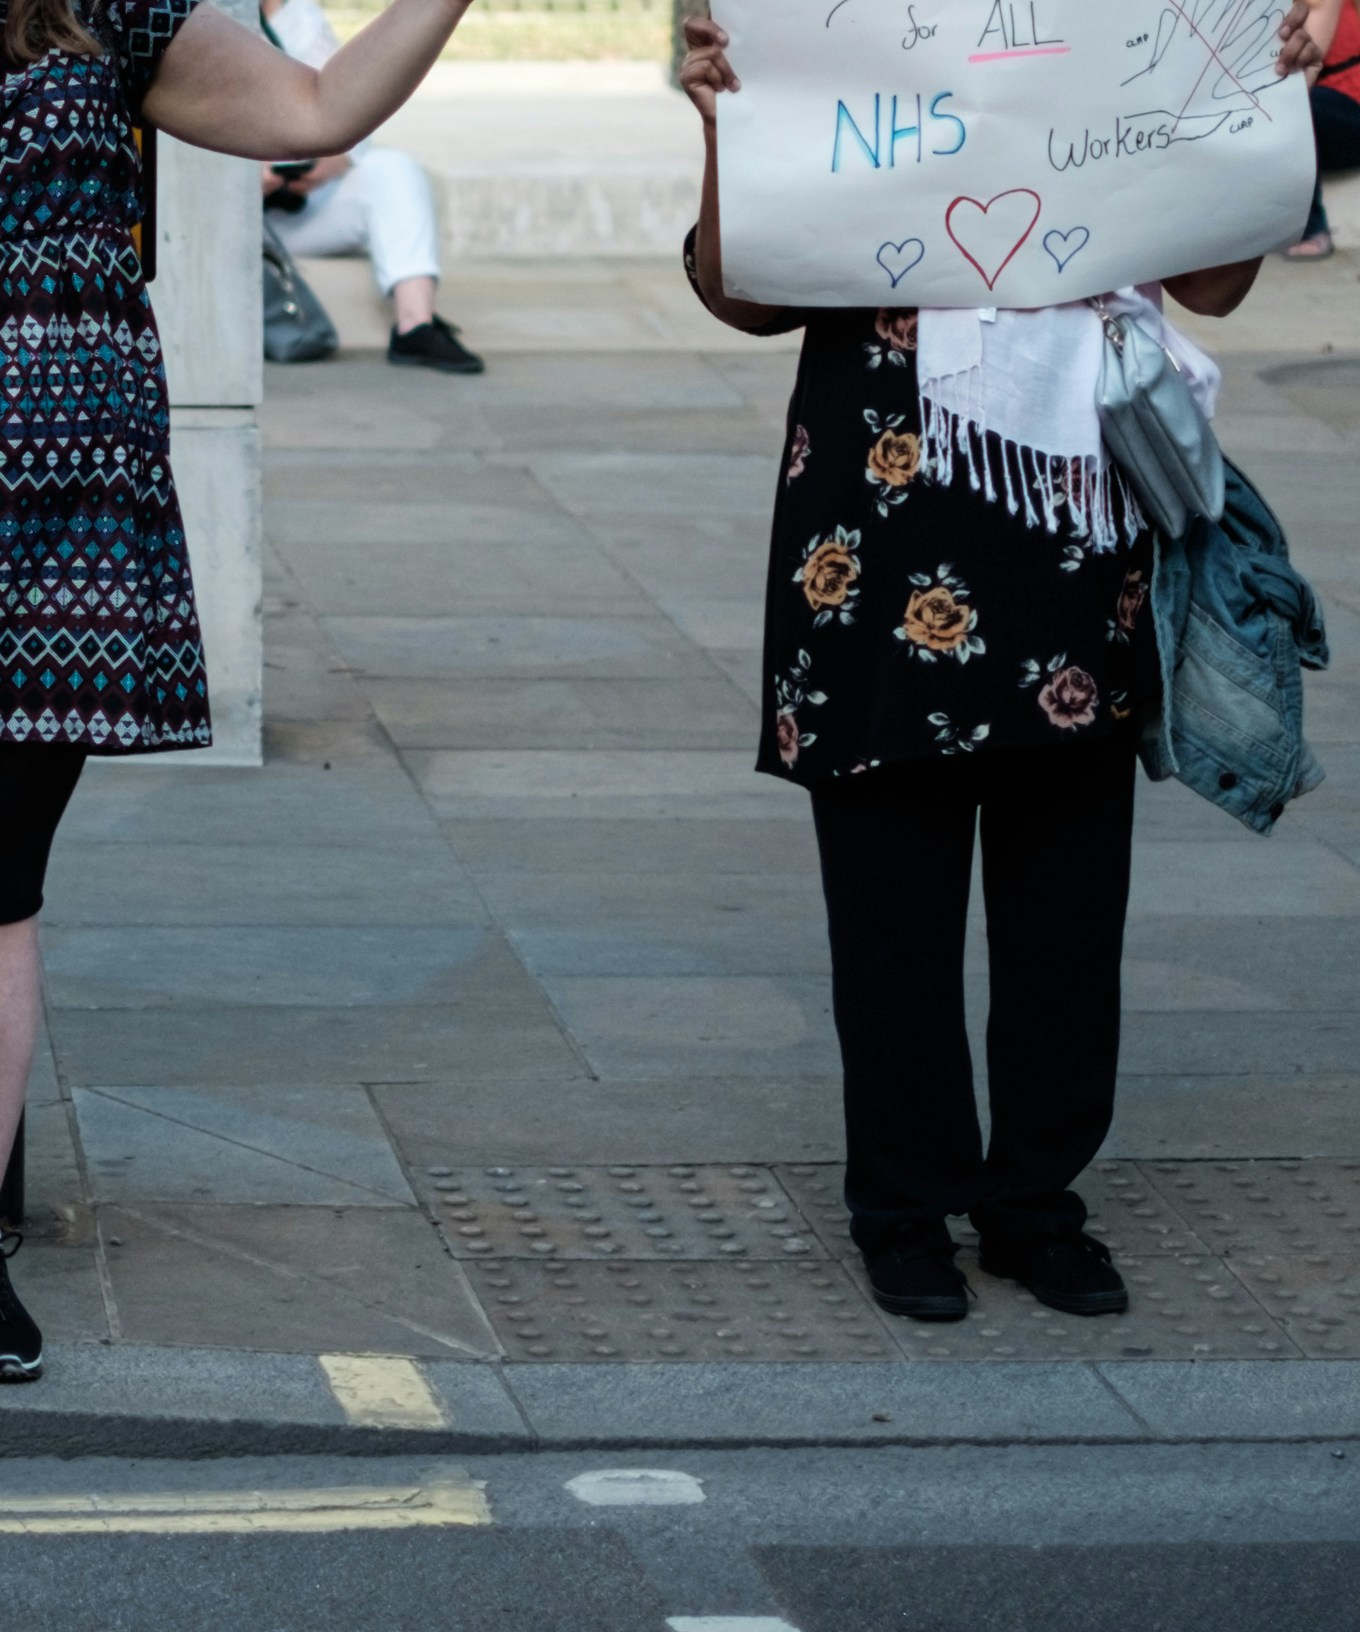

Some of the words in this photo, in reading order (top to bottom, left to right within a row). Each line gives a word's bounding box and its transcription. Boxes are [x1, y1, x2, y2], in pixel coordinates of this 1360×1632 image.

[902, 4, 938, 50] for
[832, 91, 966, 172] NHS
[1048, 117, 1171, 171] Workers
